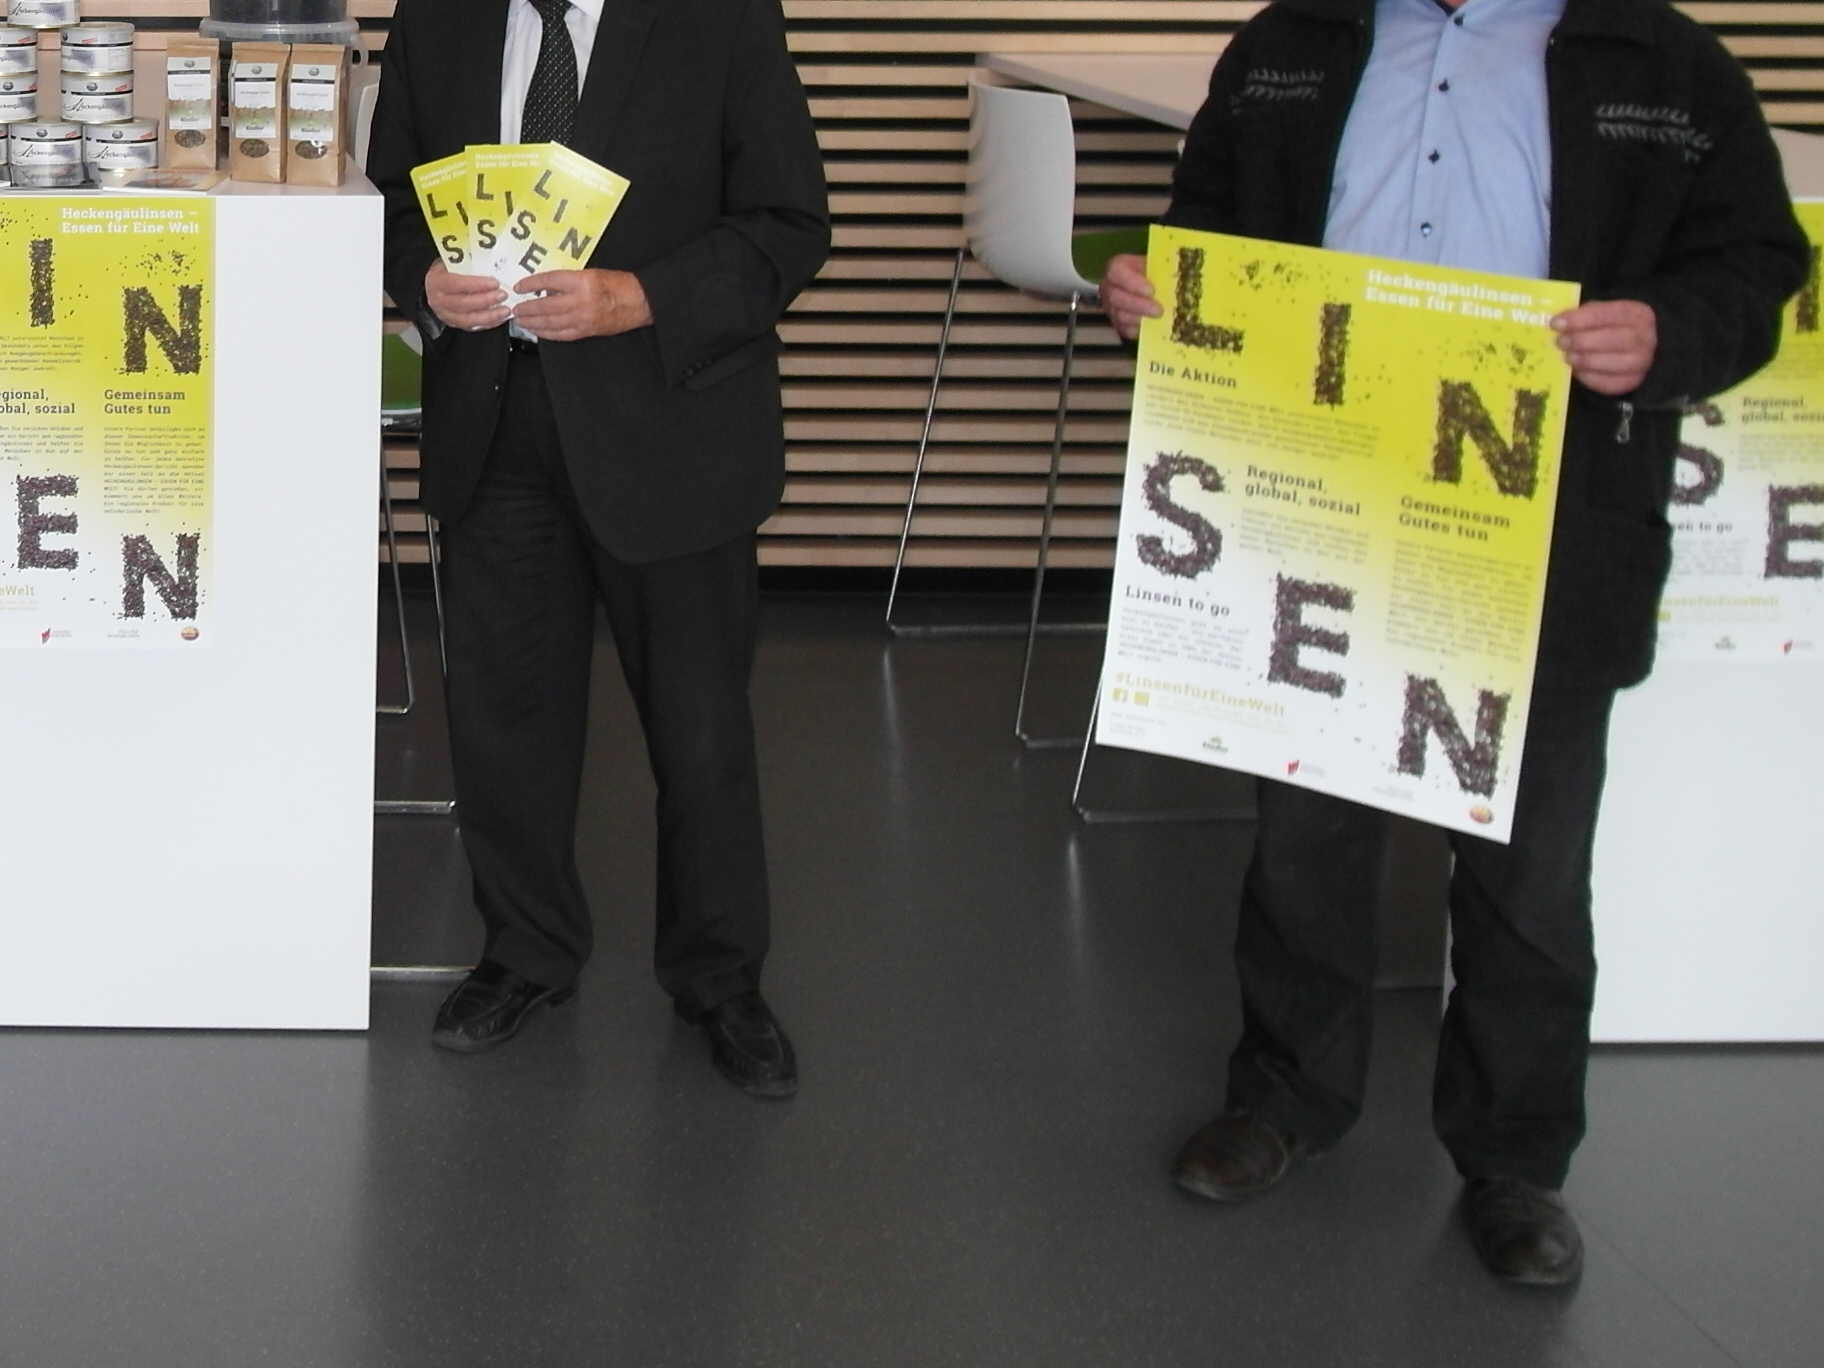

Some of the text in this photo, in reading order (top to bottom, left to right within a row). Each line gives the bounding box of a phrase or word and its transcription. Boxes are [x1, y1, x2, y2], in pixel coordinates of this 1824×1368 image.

[61, 207, 184, 222] Heckengäulinsen
[61, 221, 200, 234] Essen für Eine Welt
[1366, 268, 1533, 307] Heckengäulinsen
[1364, 285, 1550, 328] Essen für Eine Wel
[1149, 360, 1238, 389] Die Aktion
[34, 402, 76, 414] sozial
[104, 388, 186, 400] Gemeinsam
[104, 403, 172, 414] Gutes tun
[1246, 464, 1329, 494] Regional,
[1244, 481, 1362, 516] global, sozial
[1400, 494, 1511, 528] Gemeinsam
[1398, 512, 1489, 541] Gutes tun
[1124, 583, 1231, 618] Linsen to go
